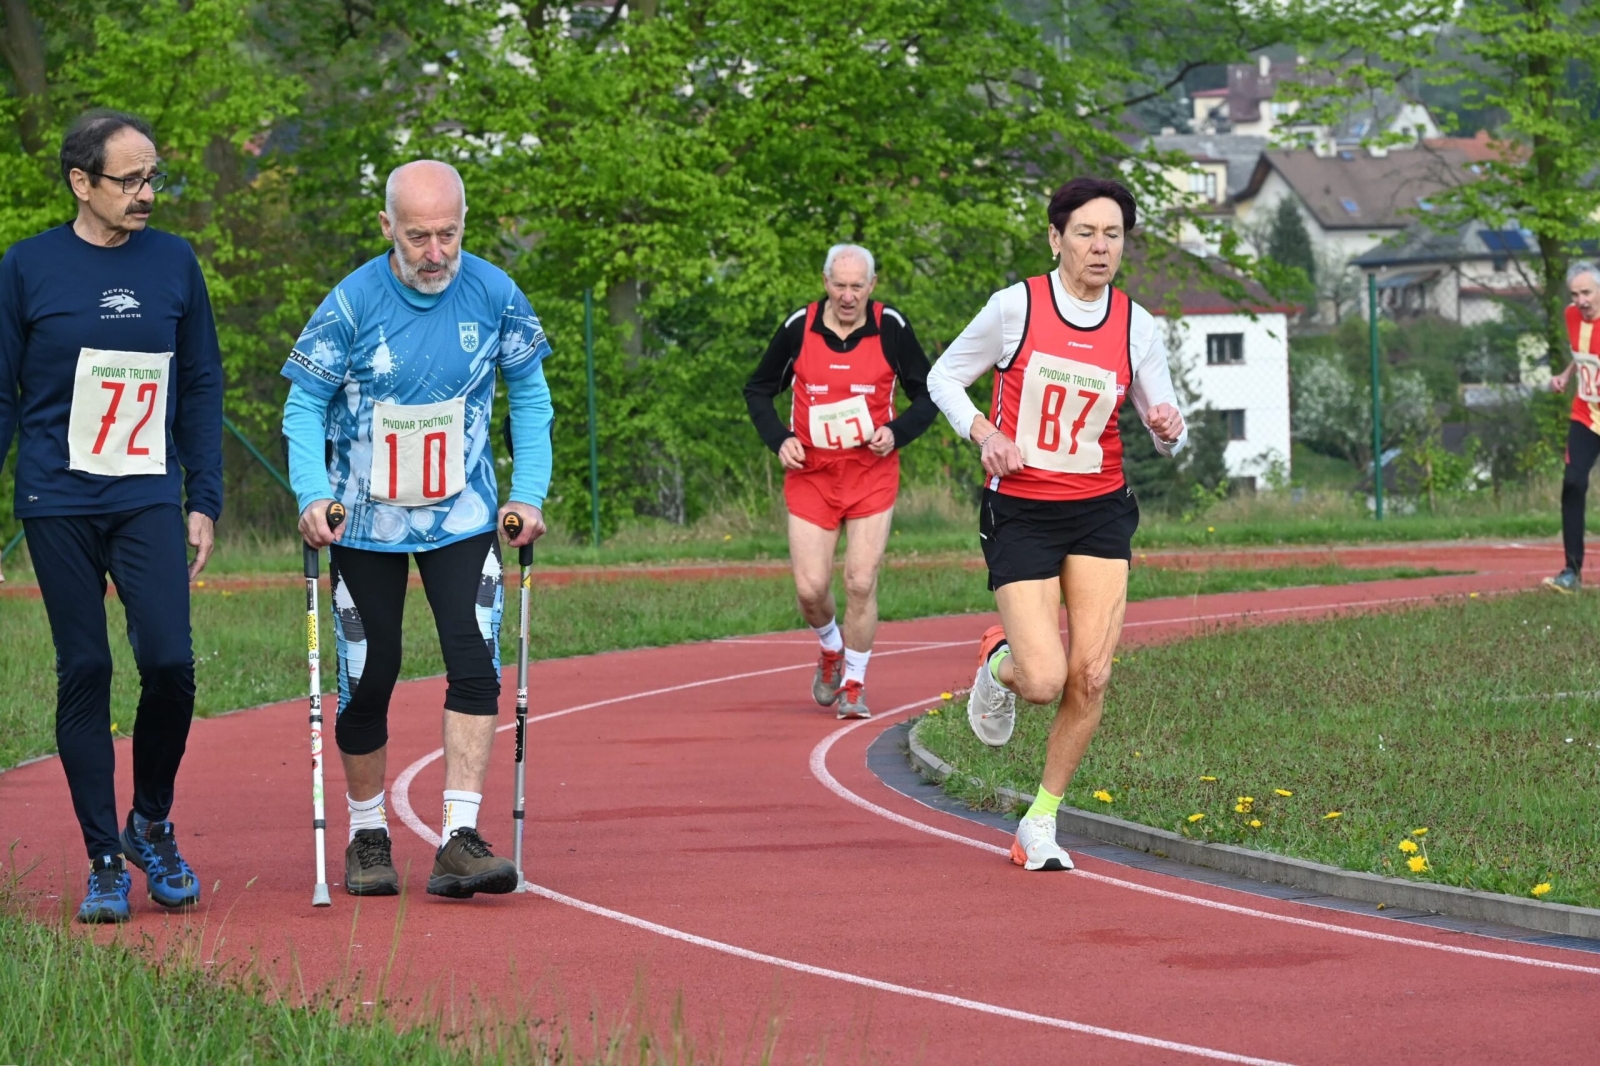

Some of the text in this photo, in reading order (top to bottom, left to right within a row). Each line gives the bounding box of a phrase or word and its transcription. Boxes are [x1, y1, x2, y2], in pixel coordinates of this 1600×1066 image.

[102, 288, 135, 296] NEVADA
[290, 350, 313, 369] OLICE
[92, 365, 163, 380] PIVOVAR TRUTNOV
[1038, 366, 1106, 390] PIVOVAR TRUTNOV
[91, 381, 158, 456] 72
[382, 413, 454, 430] PIVOVAR TRUTNOV
[1036, 383, 1101, 455] 87
[385, 431, 447, 499] 10
